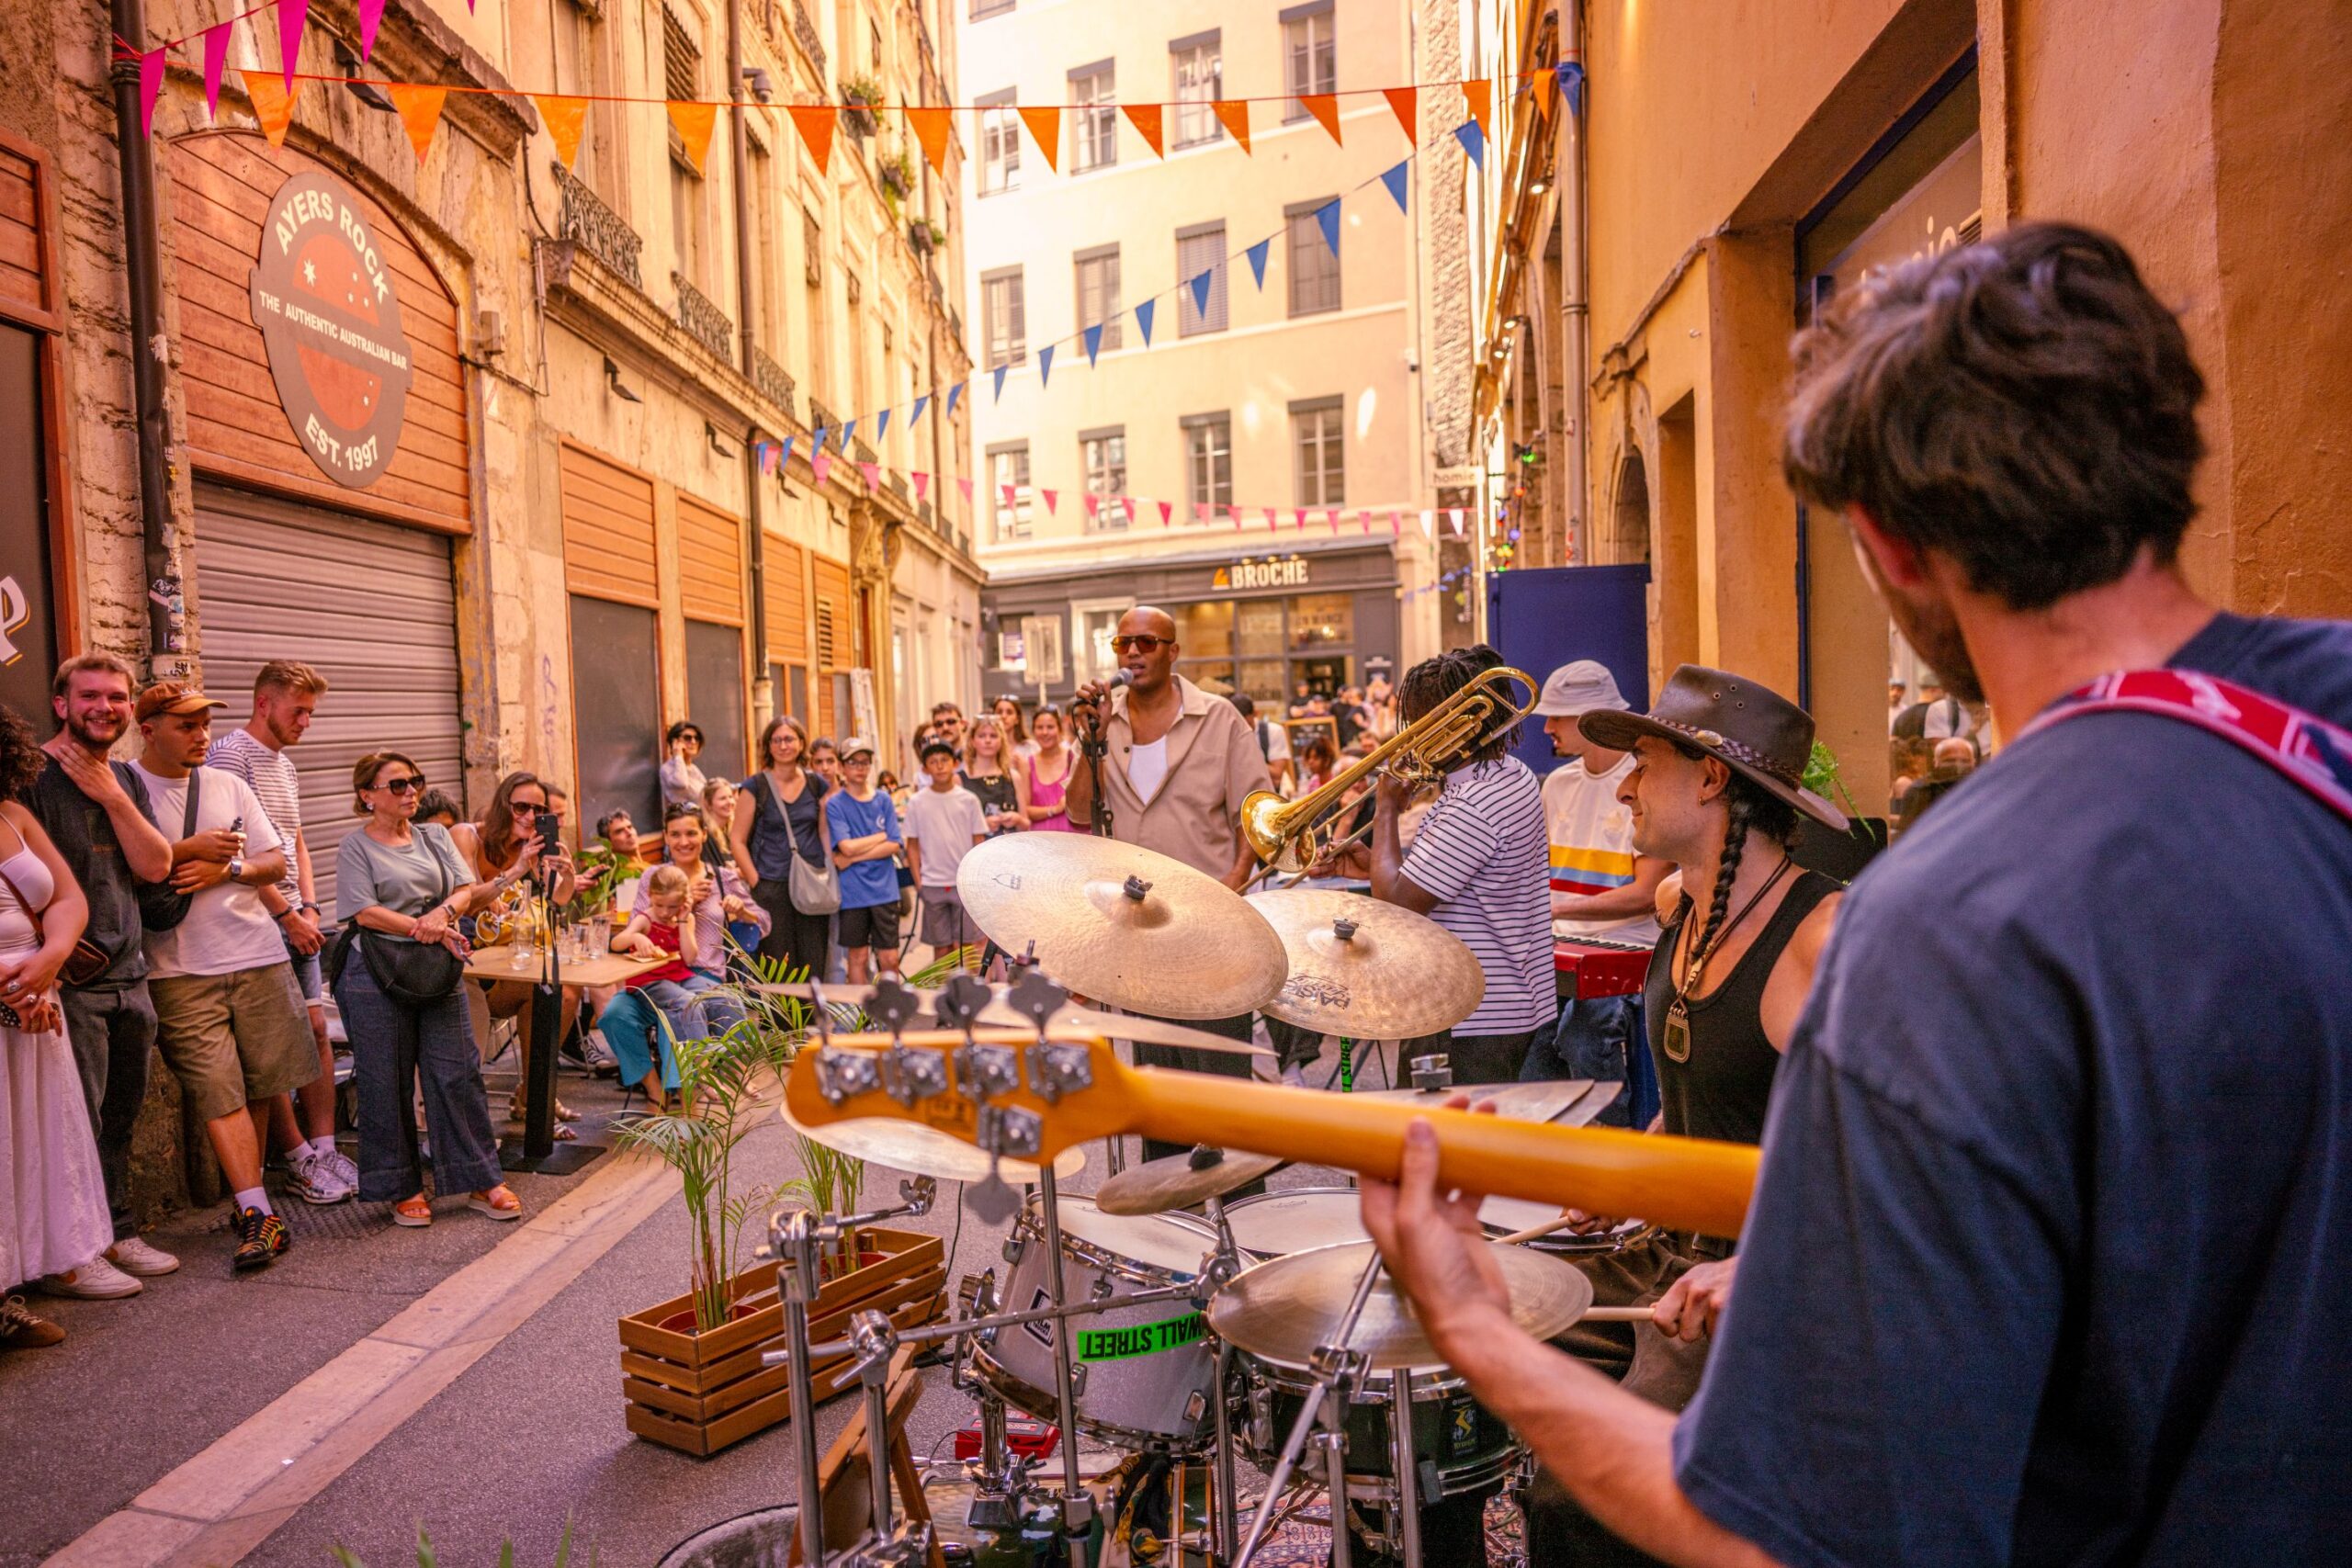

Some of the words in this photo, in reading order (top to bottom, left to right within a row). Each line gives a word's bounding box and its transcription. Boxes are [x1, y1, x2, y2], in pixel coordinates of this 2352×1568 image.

[276, 190, 334, 256] AYERS
[340, 204, 389, 304] ROCK
[259, 290, 280, 313] THE
[285, 303, 338, 339] AUTHENTIC
[339, 328, 390, 363] AUSTRALIAN
[391, 351, 407, 370] BAR
[305, 412, 341, 468] EST.
[345, 434, 378, 471] 1997
[1231, 559, 1309, 589] BROCHE
[1082, 1326, 1153, 1359] STREET
[1157, 1314, 1202, 1348] WALL
